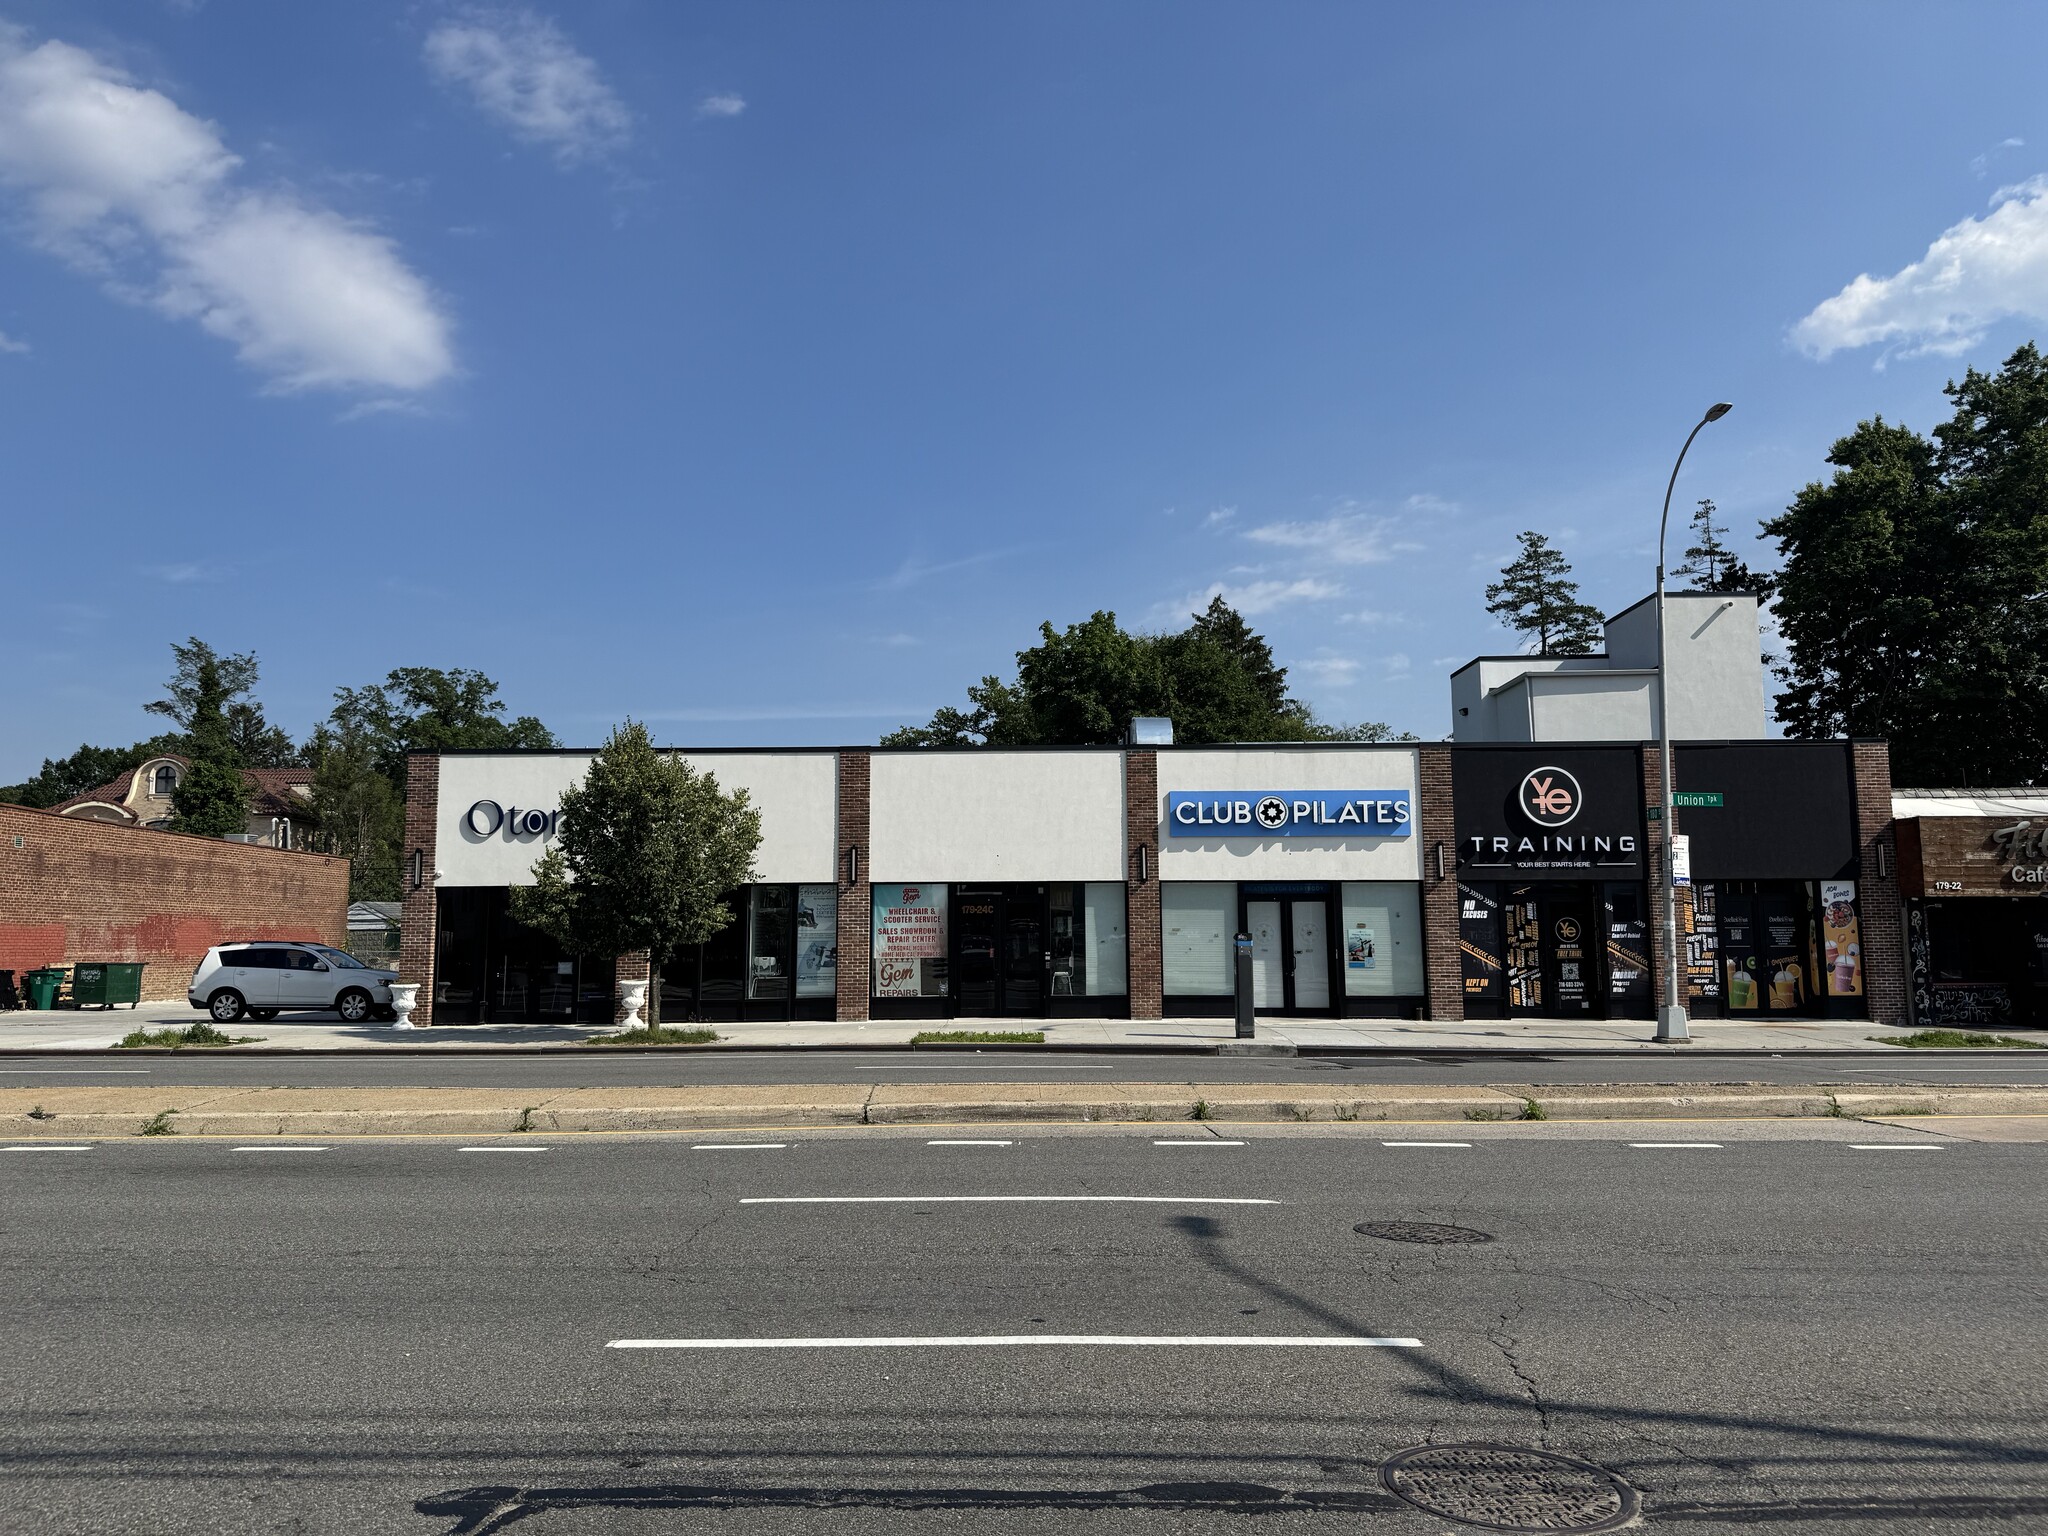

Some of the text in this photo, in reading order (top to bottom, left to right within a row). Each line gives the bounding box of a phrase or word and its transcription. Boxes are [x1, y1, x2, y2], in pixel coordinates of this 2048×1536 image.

[1677, 794, 1718, 806] Union Tpk
[1175, 800, 1411, 825] CLUB PILATES
[1471, 836, 1636, 853] TRAINING
[1825, 885, 1838, 894] ACAI
[1935, 881, 1962, 890] 179-22
[1463, 899, 1476, 910] NO
[888, 908, 929, 916] WHEELCHAIR
[961, 905, 994, 914] 179-24C
[1462, 910, 1488, 919] EXCUSES
[1683, 903, 1695, 934] ORGANIC
[1695, 913, 1716, 922] Protein
[883, 916, 941, 924] SCOOTER SERVICE
[880, 963, 914, 988] Gem
[879, 989, 919, 997] REPAIRS
